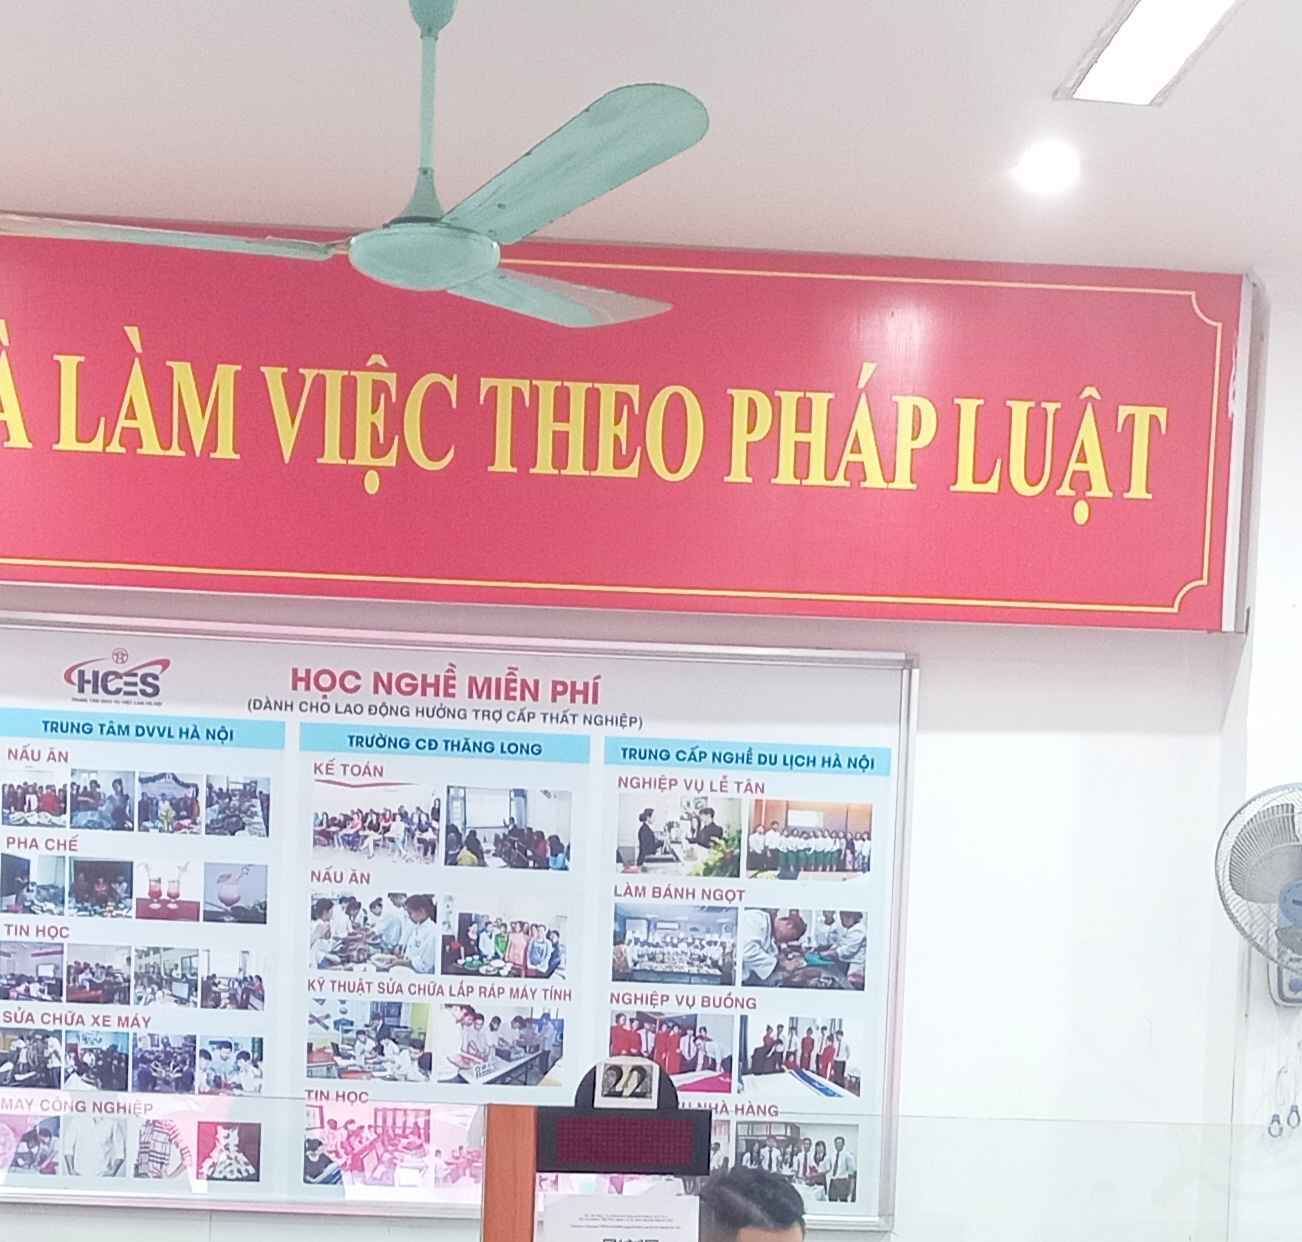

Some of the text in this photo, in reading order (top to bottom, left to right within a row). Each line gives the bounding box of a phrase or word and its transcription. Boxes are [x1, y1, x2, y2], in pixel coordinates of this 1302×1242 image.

[53, 326, 242, 460] LÀM
[260, 353, 459, 496] VIỆC
[478, 374, 705, 483] THEO
[723, 362, 939, 491] PHÁP
[949, 386, 1168, 525] LUẬT
[78, 669, 161, 698] HCES
[291, 662, 602, 705] HỌC NGHỀ MIỄN PHÍ
[247, 697, 643, 730] (DÀNH CHO LAO ĐỘNG HƯỞNG TRỢ CẤP THẤT NGHIỆP)
[42, 720, 234, 745] TRUNG TÂM DVVL HÀ NỘI
[7, 743, 69, 763] NẤU ĂN
[348, 733, 543, 756] TRƯỜNG CĐ THĂNG LONG
[313, 757, 384, 777] KẾ TOÁN
[621, 745, 875, 773] TRUNG CẤP NGHỀ DU LỊCH HÀ NỘI
[618, 774, 765, 794] NGHIỆP VỤ LỄ TÂN
[6, 834, 79, 852] PHA CHẾ
[310, 866, 371, 885] NẤU ĂN
[614, 881, 745, 904] LÀM BÁNH NGỌT
[4, 924, 70, 941] TIN HỌC
[307, 977, 572, 1001] KỸ THUẬT SỬA CHỮA LẮP RÁP MÁY TÍNH
[610, 990, 670, 1008] NGHIỆP
[675, 994, 696, 1010] VỤ
[3, 1006, 152, 1029] SỬA CHỮA XE MÁY
[603, 1064, 648, 1098] 22
[1, 1097, 154, 1117] MAY CÔNG NGHIỆP
[305, 1090, 369, 1106] TIN HỌC
[735, 1100, 779, 1117] HÀNG
